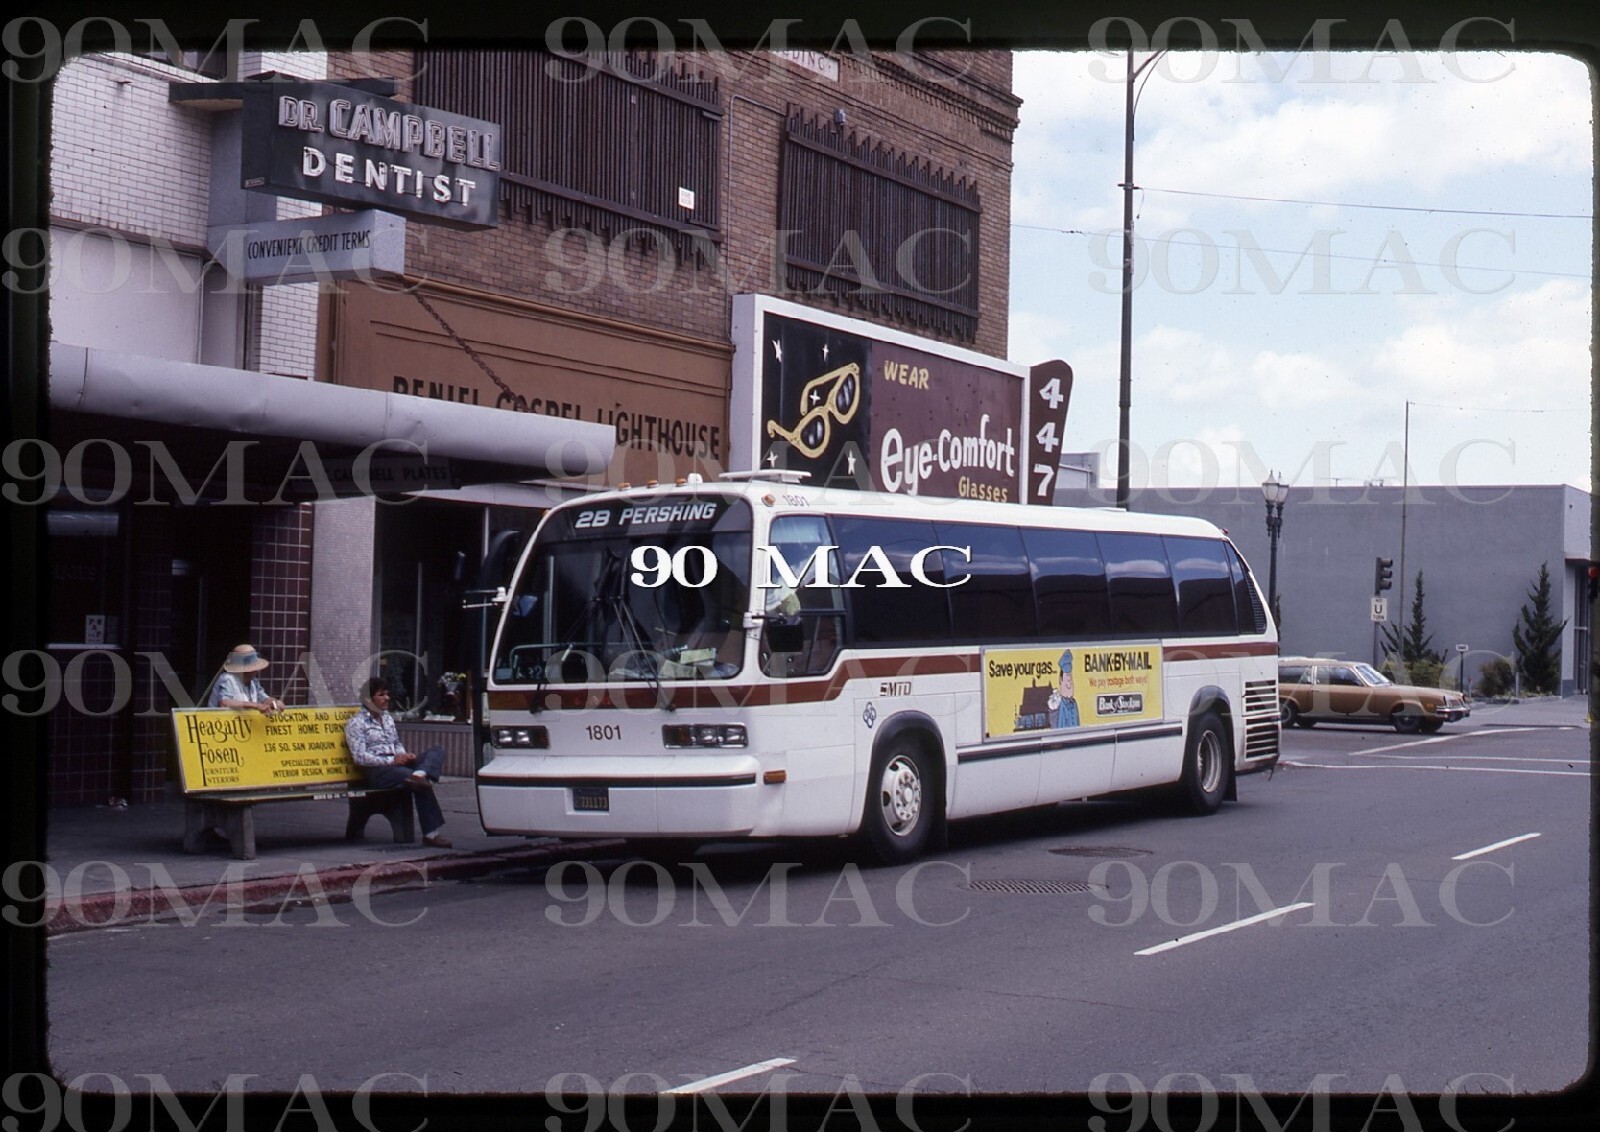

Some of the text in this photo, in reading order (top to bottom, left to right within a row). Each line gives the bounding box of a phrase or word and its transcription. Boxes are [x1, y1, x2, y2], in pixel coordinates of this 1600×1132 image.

[329, 98, 500, 171] CAMPBELL
[303, 146, 477, 207] DENTIST
[247, 230, 371, 260] CONVENIENT CREDIT TERMS
[884, 360, 930, 390] WEAR
[402, 466, 447, 481] PLATES
[782, 495, 810, 507] 1801
[618, 502, 717, 526] PERSHING
[1374, 604, 1382, 614] U
[989, 660, 1012, 678] Save
[1013, 662, 1035, 680] your
[315, 712, 330, 721] AND
[184, 714, 254, 744] Heagarty
[265, 724, 292, 736] FINEST
[297, 723, 320, 735] HOME
[585, 724, 622, 741] 1801
[199, 742, 245, 769] Fosen
[264, 743, 276, 753] 136
[293, 742, 306, 751] SAN
[307, 741, 336, 751] JOAQUIN
[280, 759, 321, 768] SPECIALIZING
[321, 758, 329, 766] IN
[272, 769, 300, 779] INTERIOR
[326, 766, 343, 775] HOME
